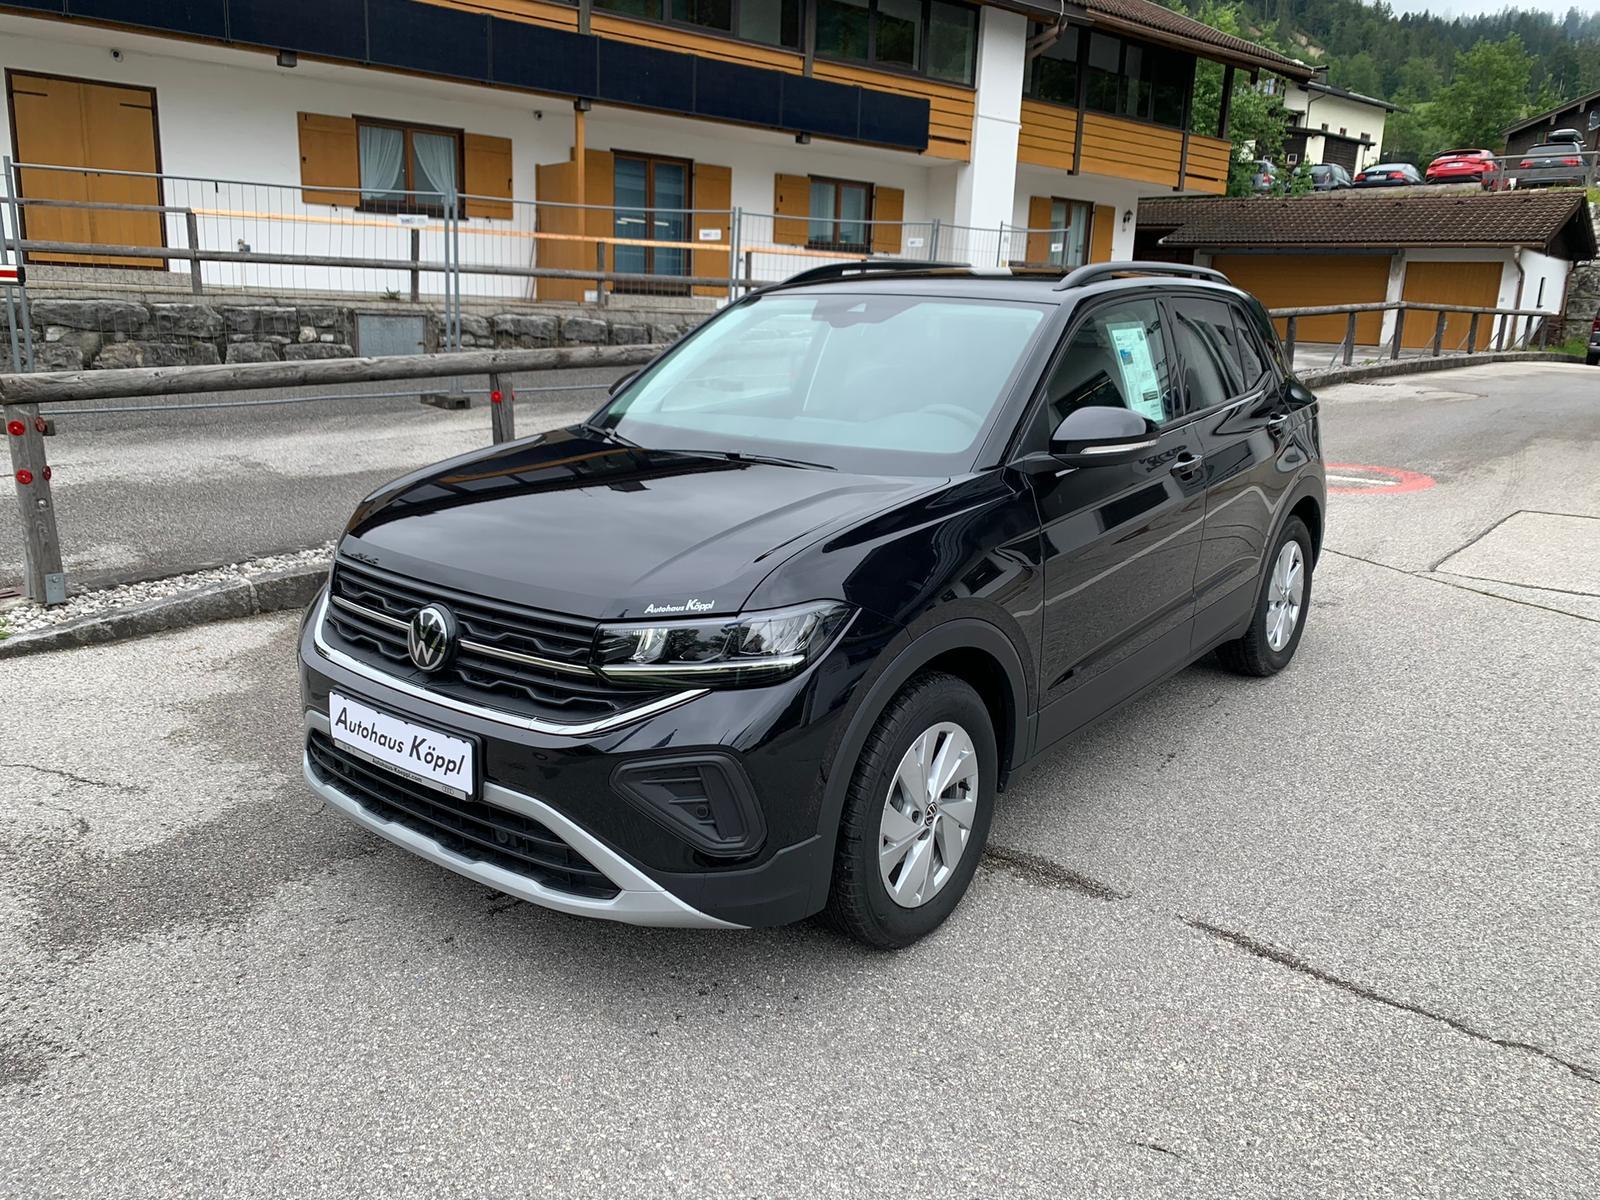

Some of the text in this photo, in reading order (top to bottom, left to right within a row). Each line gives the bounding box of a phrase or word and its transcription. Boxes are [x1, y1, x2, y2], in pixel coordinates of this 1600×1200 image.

[644, 599, 715, 614] Autohaus Köppl
[335, 707, 465, 776] Autohaus Köppl
